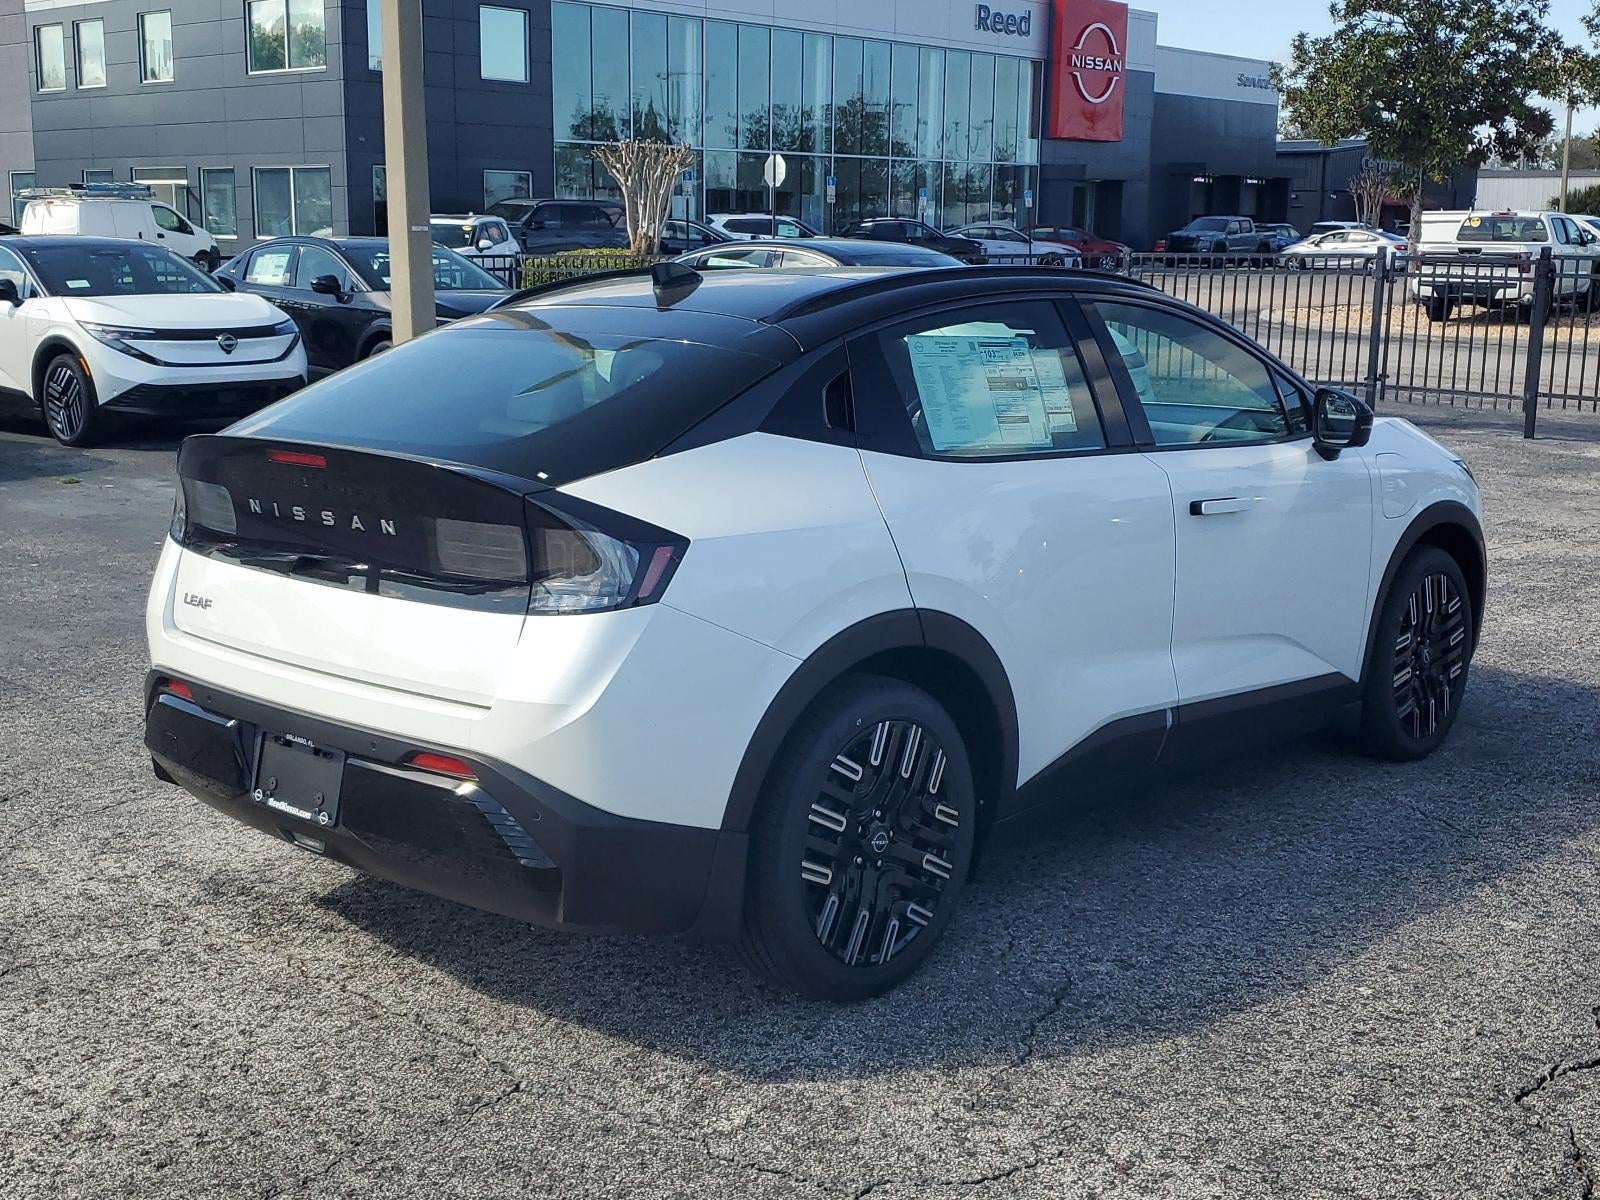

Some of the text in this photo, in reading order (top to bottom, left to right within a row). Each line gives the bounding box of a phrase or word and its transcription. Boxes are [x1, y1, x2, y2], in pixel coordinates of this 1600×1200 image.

[975, 3, 1031, 37] Reed
[1071, 53, 1122, 73] NISSAN
[248, 498, 397, 536] NISSAN
[183, 592, 213, 610] LEAF
[285, 733, 307, 746] ORLANDO,
[268, 798, 312, 820] ReedNissan.com
